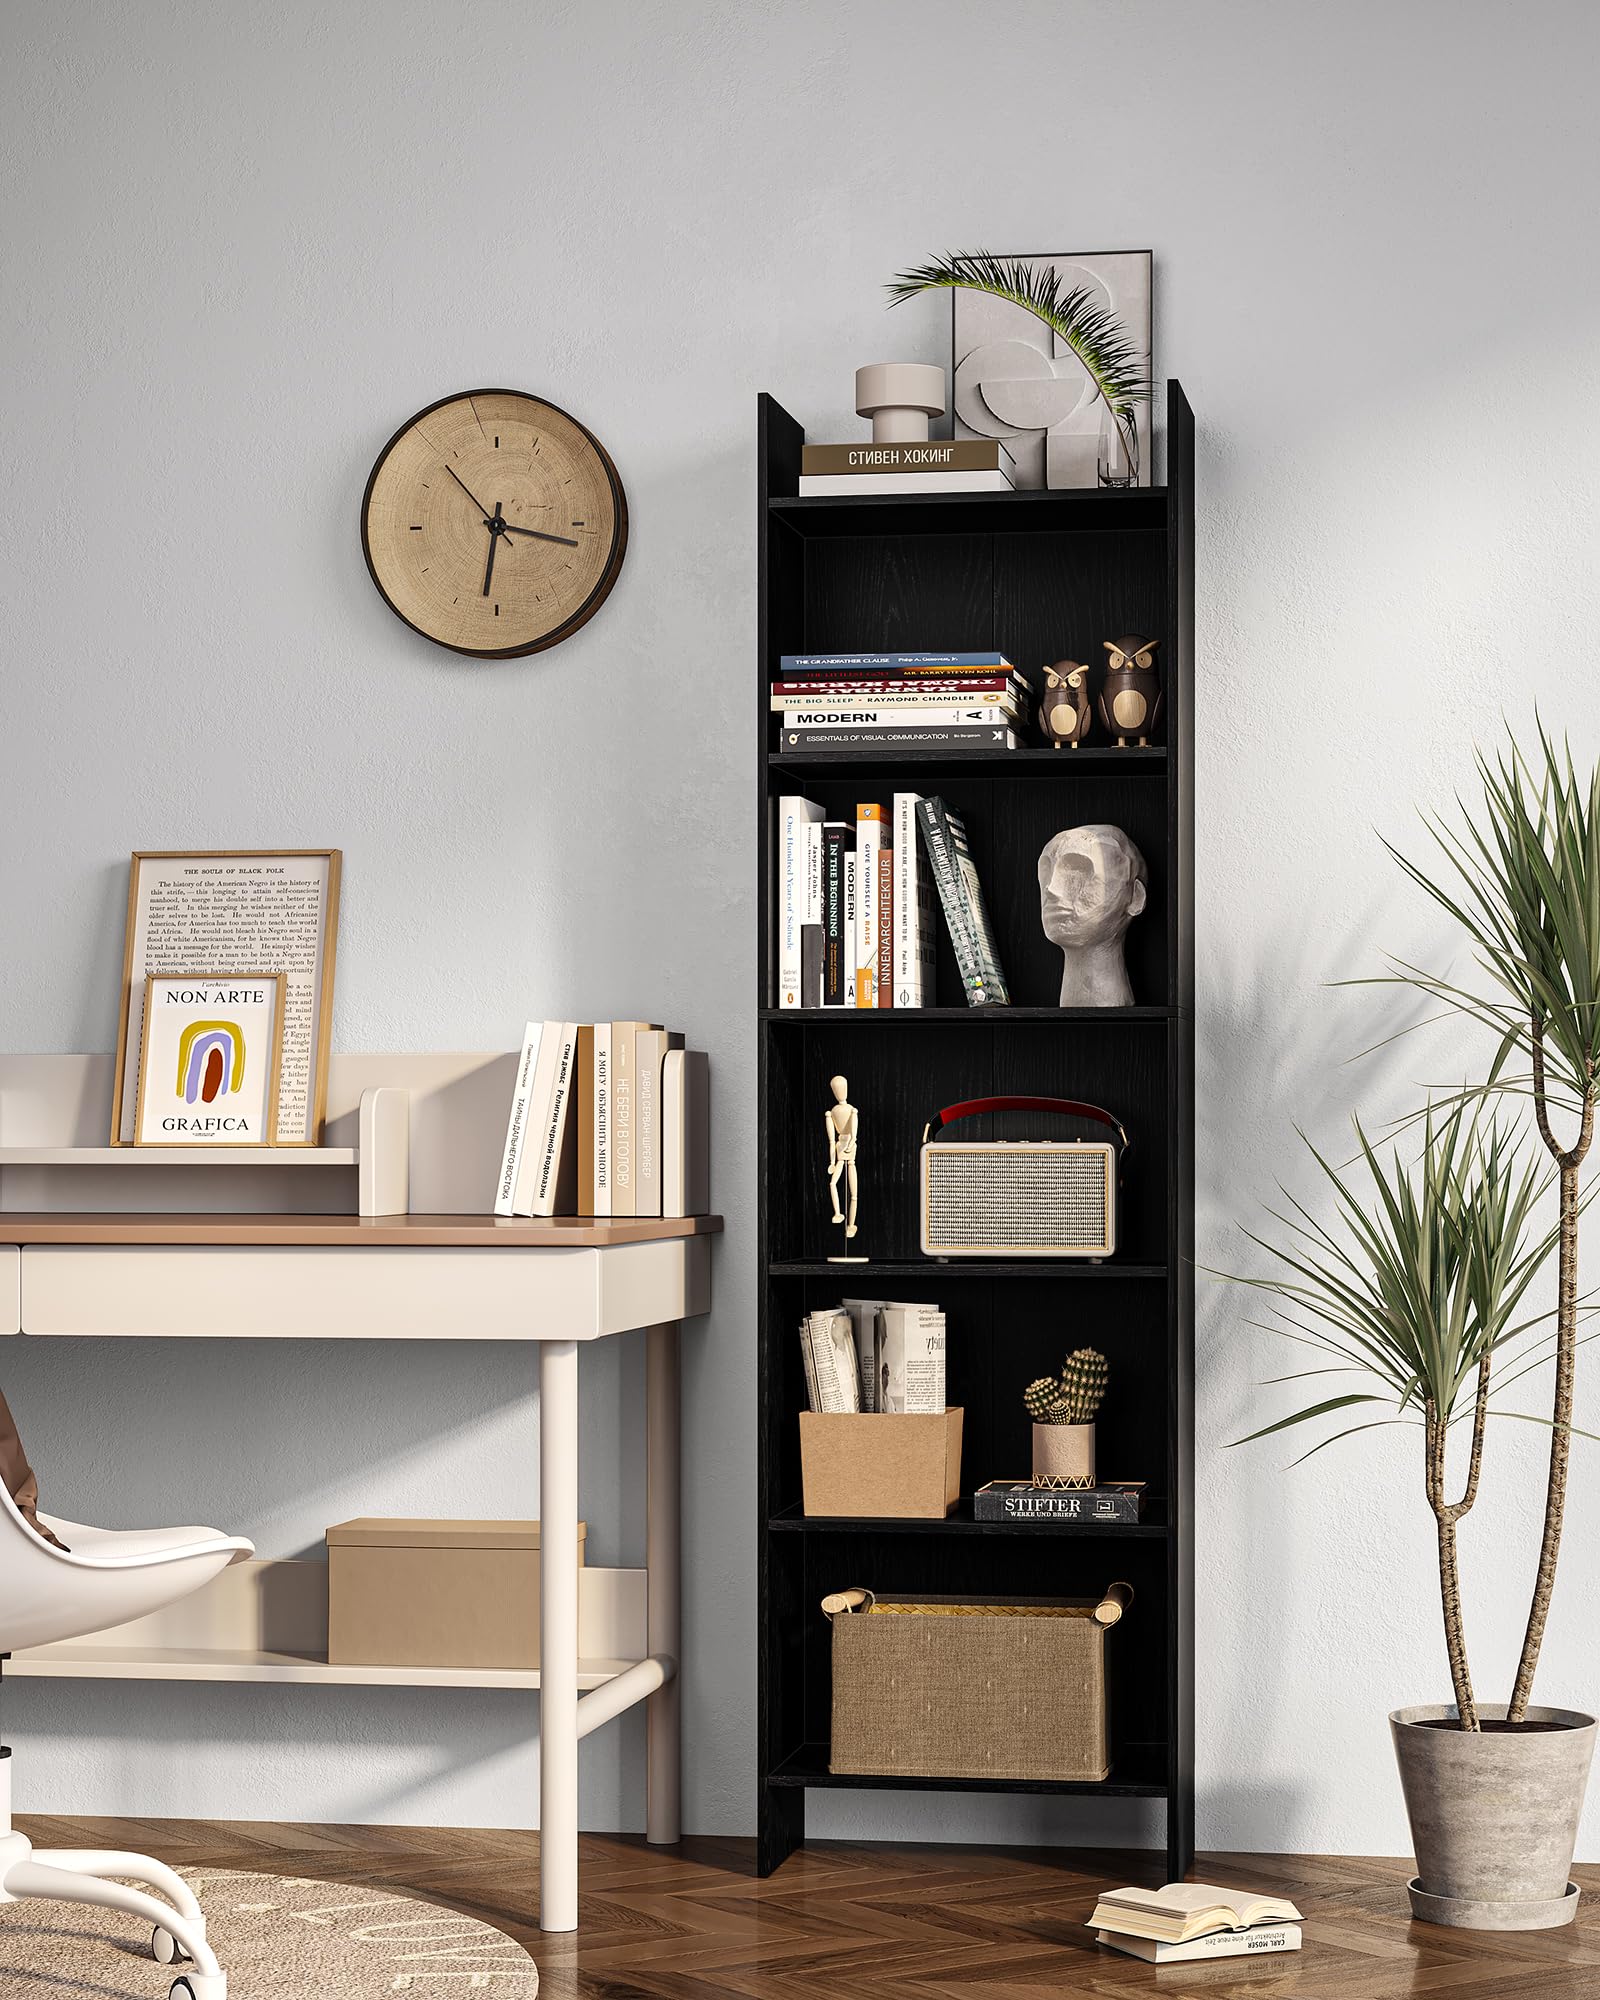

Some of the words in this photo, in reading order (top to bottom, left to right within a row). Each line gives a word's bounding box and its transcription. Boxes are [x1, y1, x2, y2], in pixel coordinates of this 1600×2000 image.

[849, 450, 899, 465] СТИВЕН
[903, 448, 954, 463] ХОКИНГ
[819, 686, 958, 694] HANNIBAL
[888, 679, 996, 687] THOMAS
[797, 713, 877, 723] MODERN
[966, 711, 982, 719] A
[830, 844, 838, 855] IN
[830, 858, 838, 877] THE
[173, 881, 194, 889] history
[248, 880, 268, 888] Negro
[289, 879, 311, 887] history
[212, 888, 236, 896] longing
[787, 903, 794, 913] of
[830, 880, 838, 937] BEGINNING
[881, 859, 891, 985] INNENARCHITEKTUR
[786, 916, 794, 950] Solitude
[166, 991, 208, 1003] NON
[214, 990, 264, 1003] ARTE
[848, 986, 855, 997] A
[598, 1060, 607, 1085] МОГУ
[617, 1078, 629, 1093] НЕ
[641, 1069, 652, 1099] ДАВИД
[552, 1089, 564, 1123] Религия
[617, 1097, 629, 1128] БЕРИ
[162, 1118, 249, 1130] GRAFICA
[598, 1089, 607, 1146] ОБЪЯСНИТЬ
[546, 1124, 559, 1153] черной
[617, 1130, 629, 1138] В
[507, 1124, 521, 1163] ДАЛЬНЕГО
[598, 1149, 607, 1188] МНОГОЕ
[616, 1141, 629, 1188] ГОЛОВУ
[501, 1165, 513, 1200] ВОСТОКА
[539, 1155, 552, 1199] водолазки
[1005, 1498, 1081, 1512] STIFTER
[1255, 1932, 1285, 1941] Architektur
[1270, 1939, 1285, 1947] CARL
